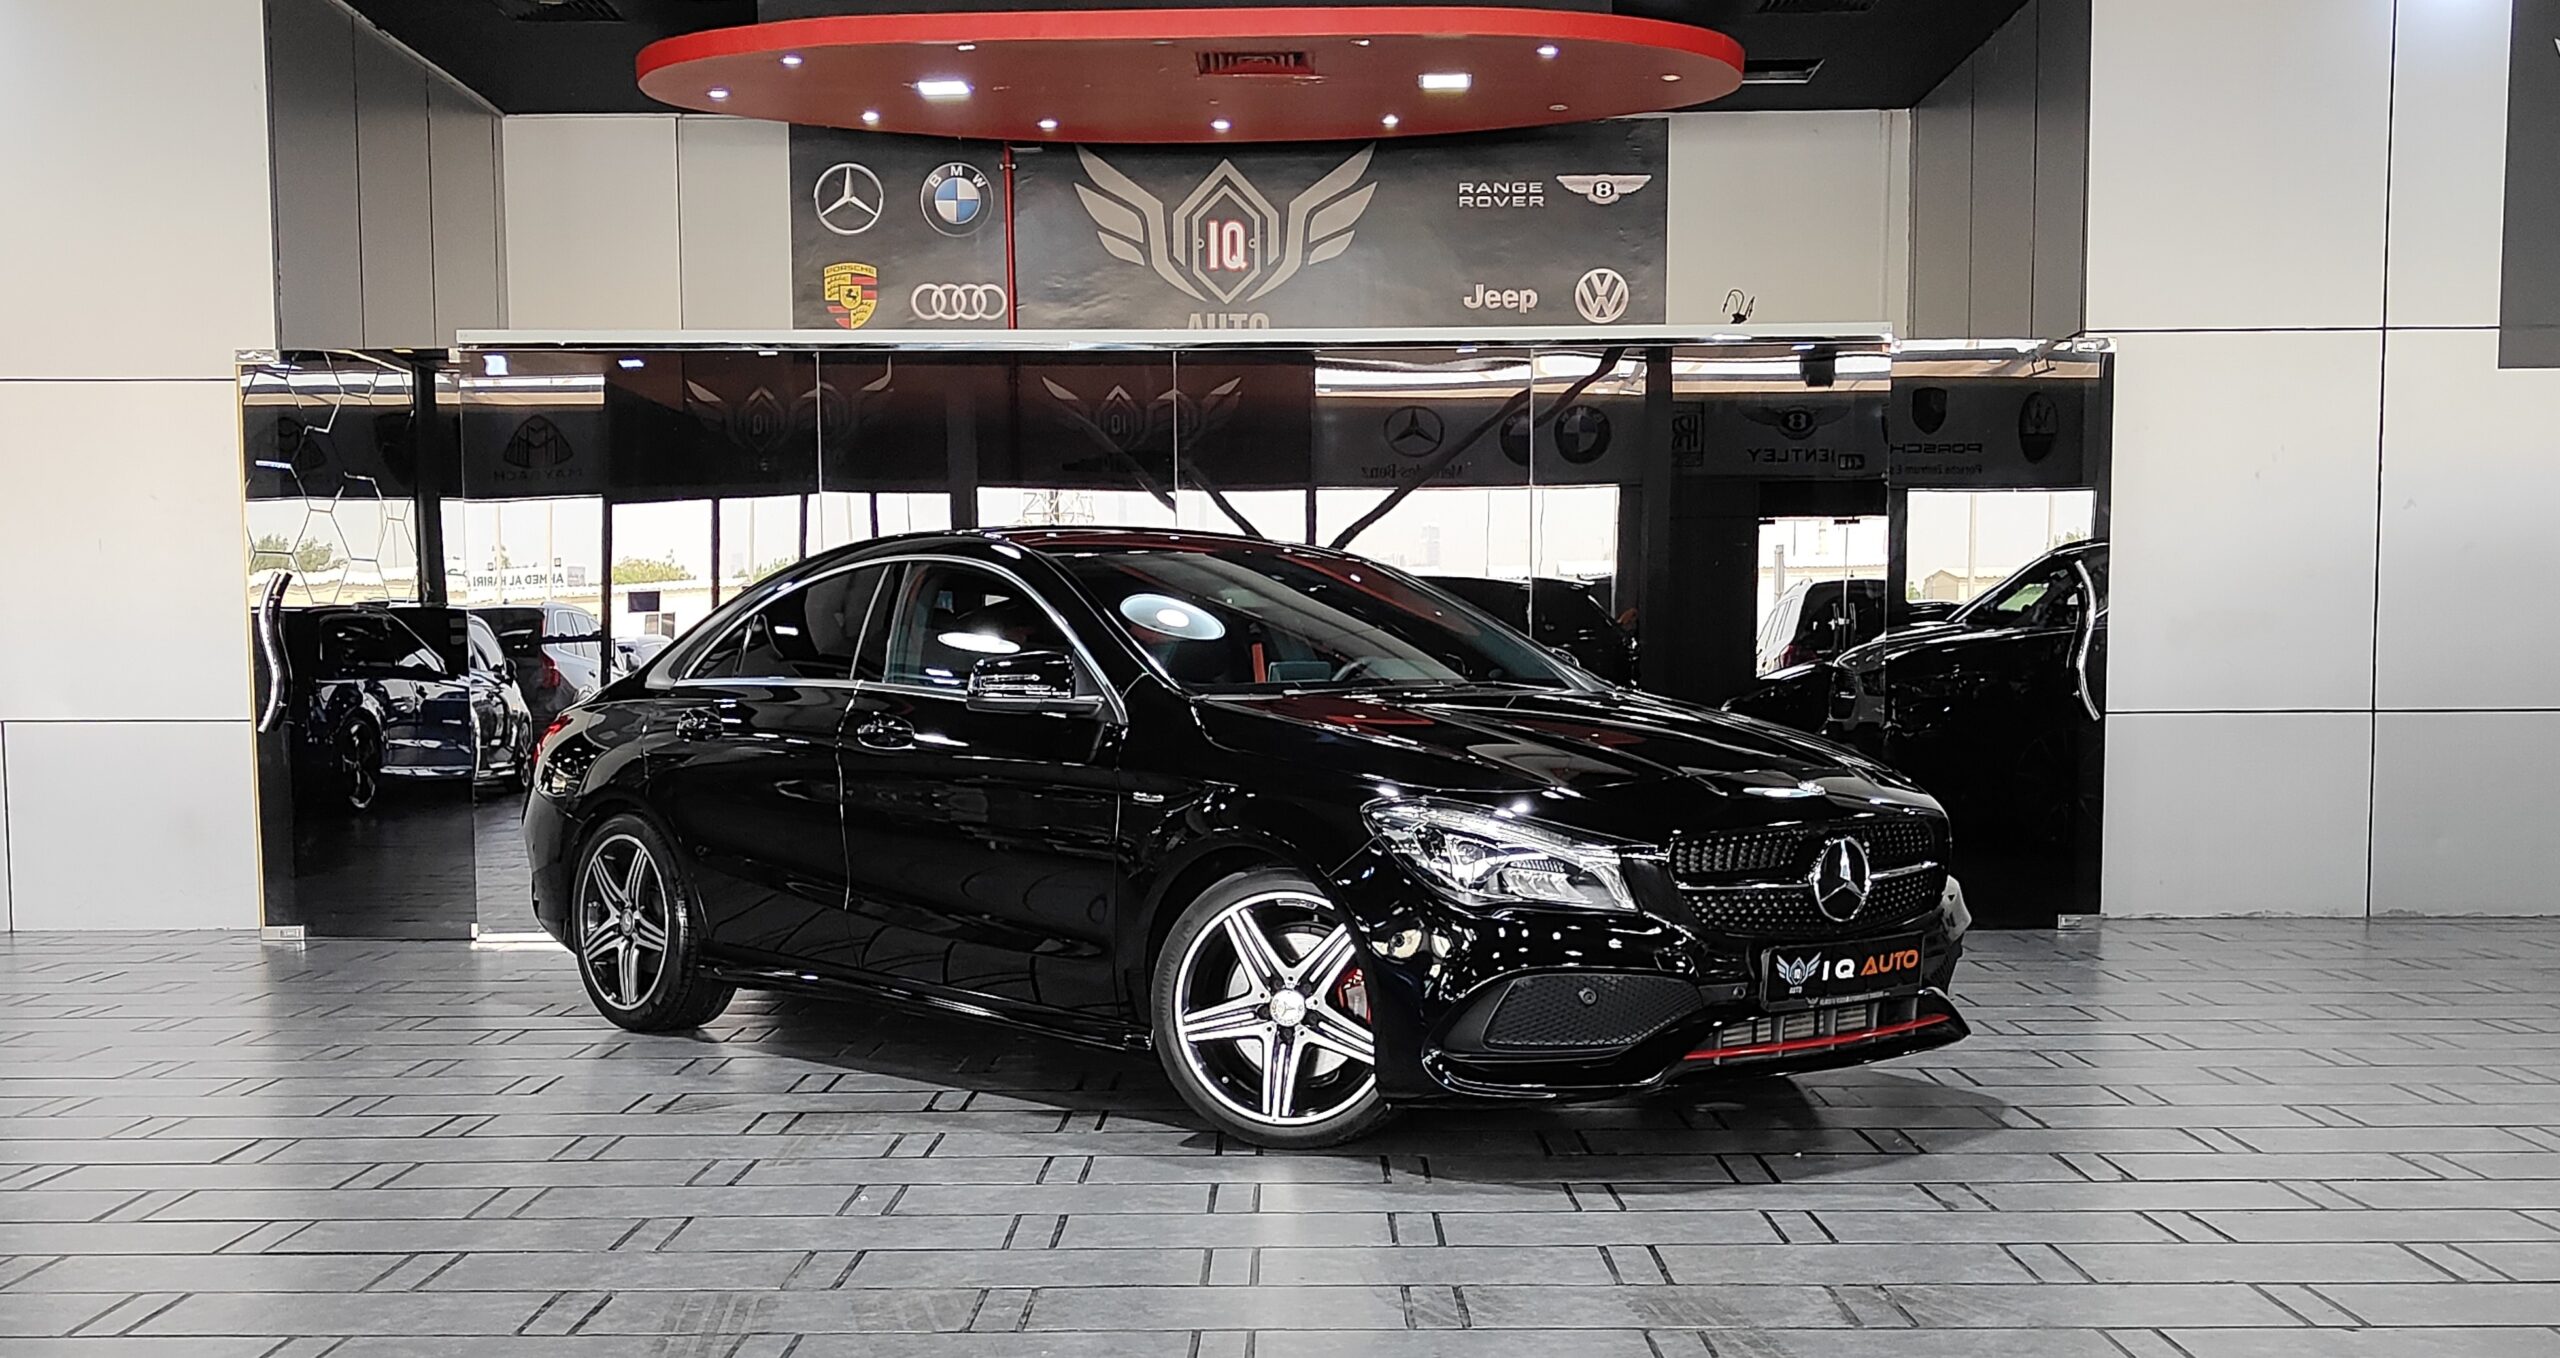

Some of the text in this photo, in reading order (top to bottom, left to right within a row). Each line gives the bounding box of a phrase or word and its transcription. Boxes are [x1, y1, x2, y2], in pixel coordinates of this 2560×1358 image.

[929, 165, 986, 188] BMW
[1458, 182, 1544, 194] RANGE
[1458, 196, 1545, 208] ROVER
[1208, 220, 1248, 270] IQ
[826, 265, 876, 275] PORSCHE
[1463, 283, 1539, 314] Jeep
[1860, 949, 1919, 976] AUTO
